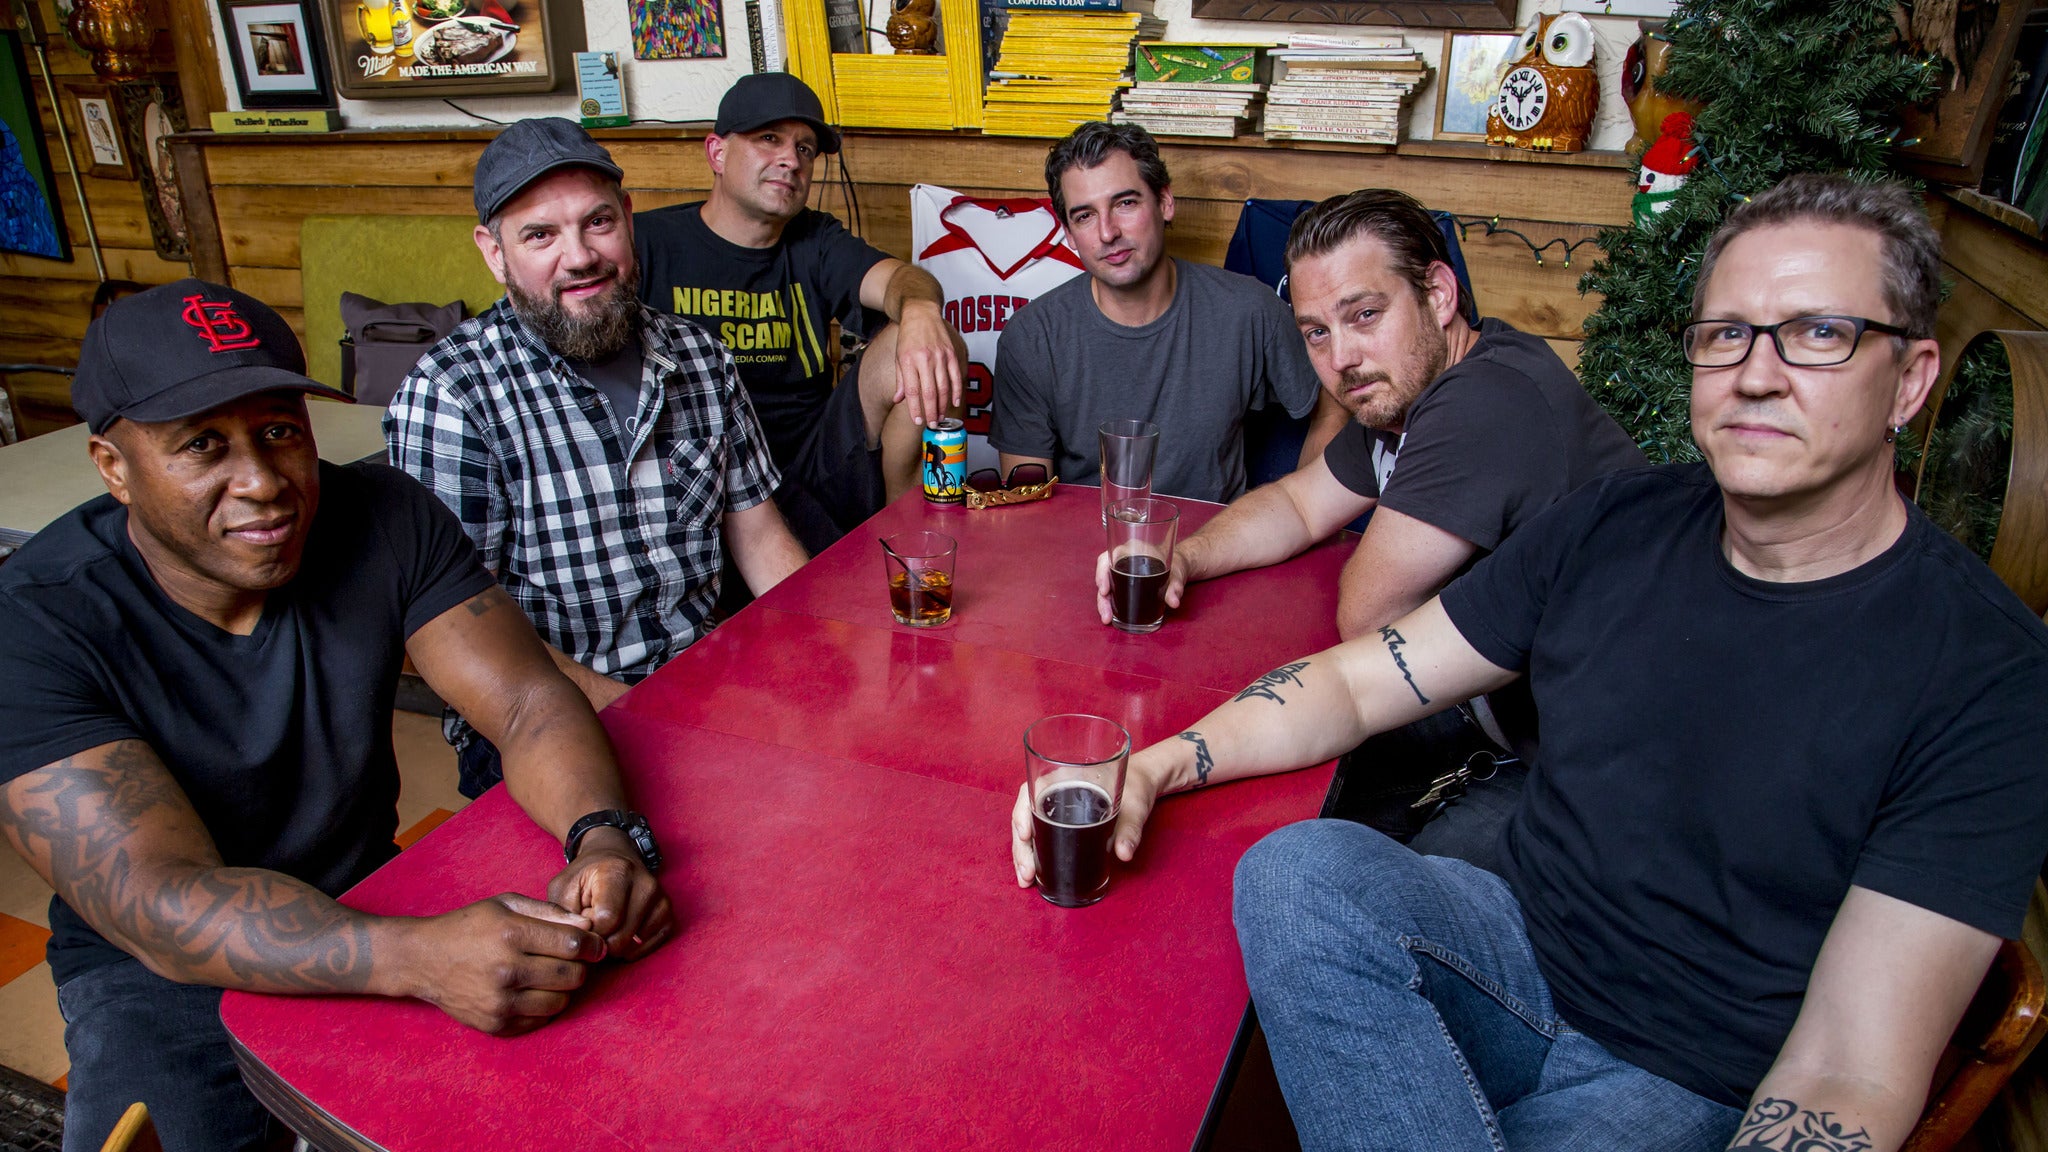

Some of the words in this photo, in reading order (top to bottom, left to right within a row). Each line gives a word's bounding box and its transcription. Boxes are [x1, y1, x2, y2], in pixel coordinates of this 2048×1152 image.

[751, 7, 761, 32] FUNK
[358, 55, 396, 78] Miller
[398, 66, 430, 77] MADE
[430, 65, 451, 76] THE
[453, 62, 512, 76] AMERICAN
[512, 61, 538, 72] WAY
[673, 286, 786, 319] NIGERIAN
[720, 321, 792, 350] SCAM
